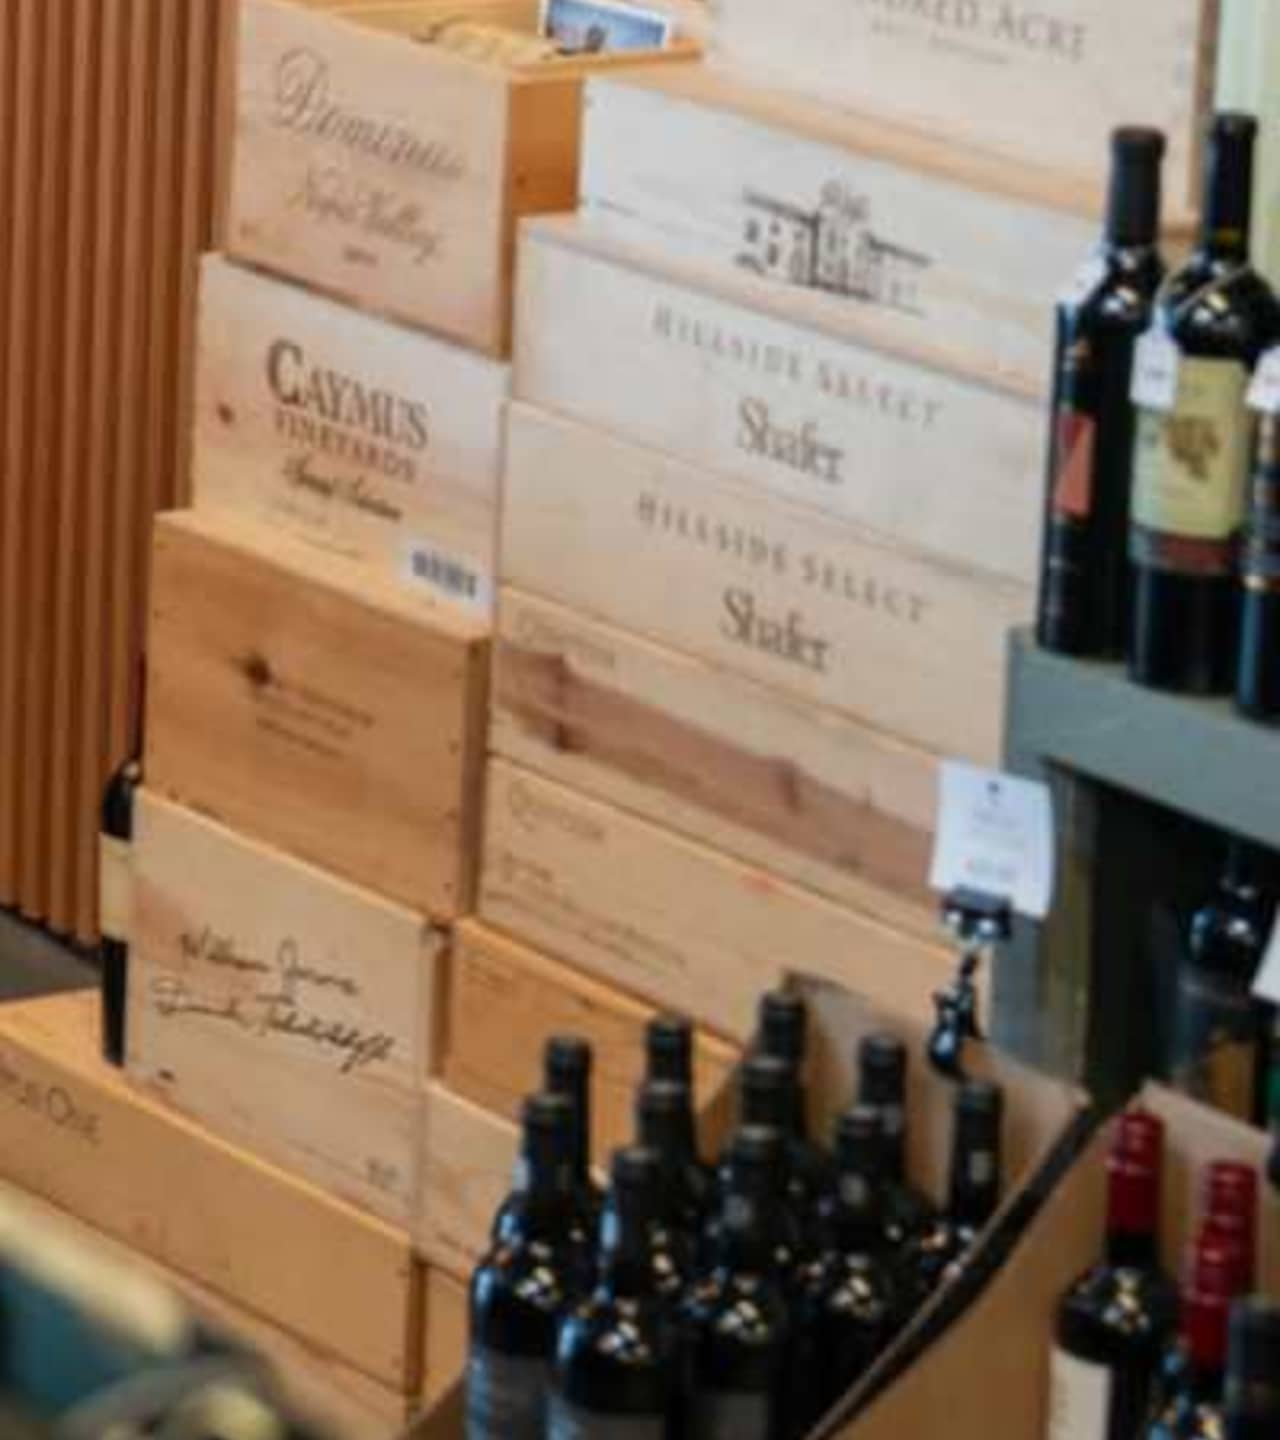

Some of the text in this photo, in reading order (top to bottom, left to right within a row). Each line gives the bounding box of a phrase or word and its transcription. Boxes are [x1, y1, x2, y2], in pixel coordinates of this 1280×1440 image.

[266, 338, 430, 452] CAYMUS
[274, 408, 417, 483] VINEYARDS
[738, 396, 844, 484] Shafer
[634, 490, 931, 623] HILLSIDE SELECT
[720, 586, 830, 674] Shafer
